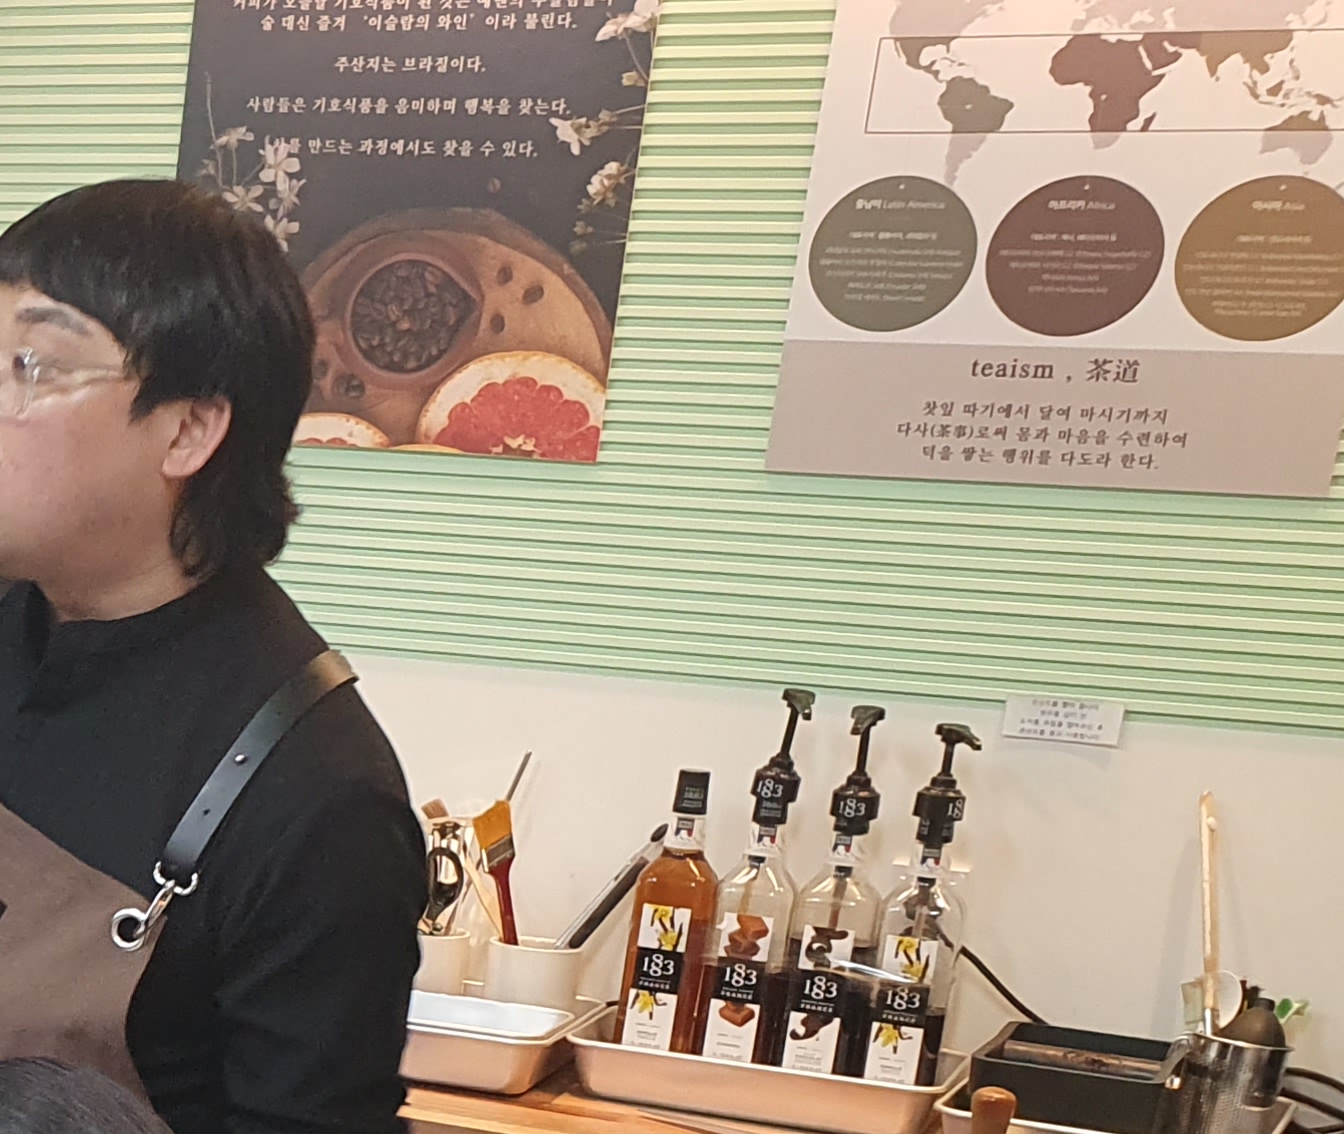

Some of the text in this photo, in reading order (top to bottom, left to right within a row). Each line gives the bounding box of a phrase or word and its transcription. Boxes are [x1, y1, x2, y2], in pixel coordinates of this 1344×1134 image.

[261, 15, 275, 31] 술
[281, 14, 310, 31] 대신
[485, 13, 517, 30] 이라
[524, 12, 577, 30] 불린다.
[334, 55, 487, 74] 주산지는 브라질이다.
[246, 96, 572, 115] 사람들은 기호식품을 음미하며 행복을 찾는다.
[308, 138, 353, 155] 만드는
[358, 138, 436, 157] 과정에서도
[443, 139, 474, 157] 찾을
[480, 140, 496, 157] 수
[502, 139, 538, 158] 있다.
[971, 358, 1055, 380] teaism
[1085, 358, 1140, 383] 茶道
[922, 400, 1169, 425] 찻잎 따기에서 달여 마시기까지
[1016, 425, 1050, 443] 몸과
[1057, 427, 1110, 445] 마음을
[1116, 429, 1189, 449] 수련하여
[922, 444, 954, 460] 덕을
[1002, 447, 1052, 466] 행위를
[1060, 450, 1112, 468] 다도라
[1120, 452, 1159, 470] 한다.
